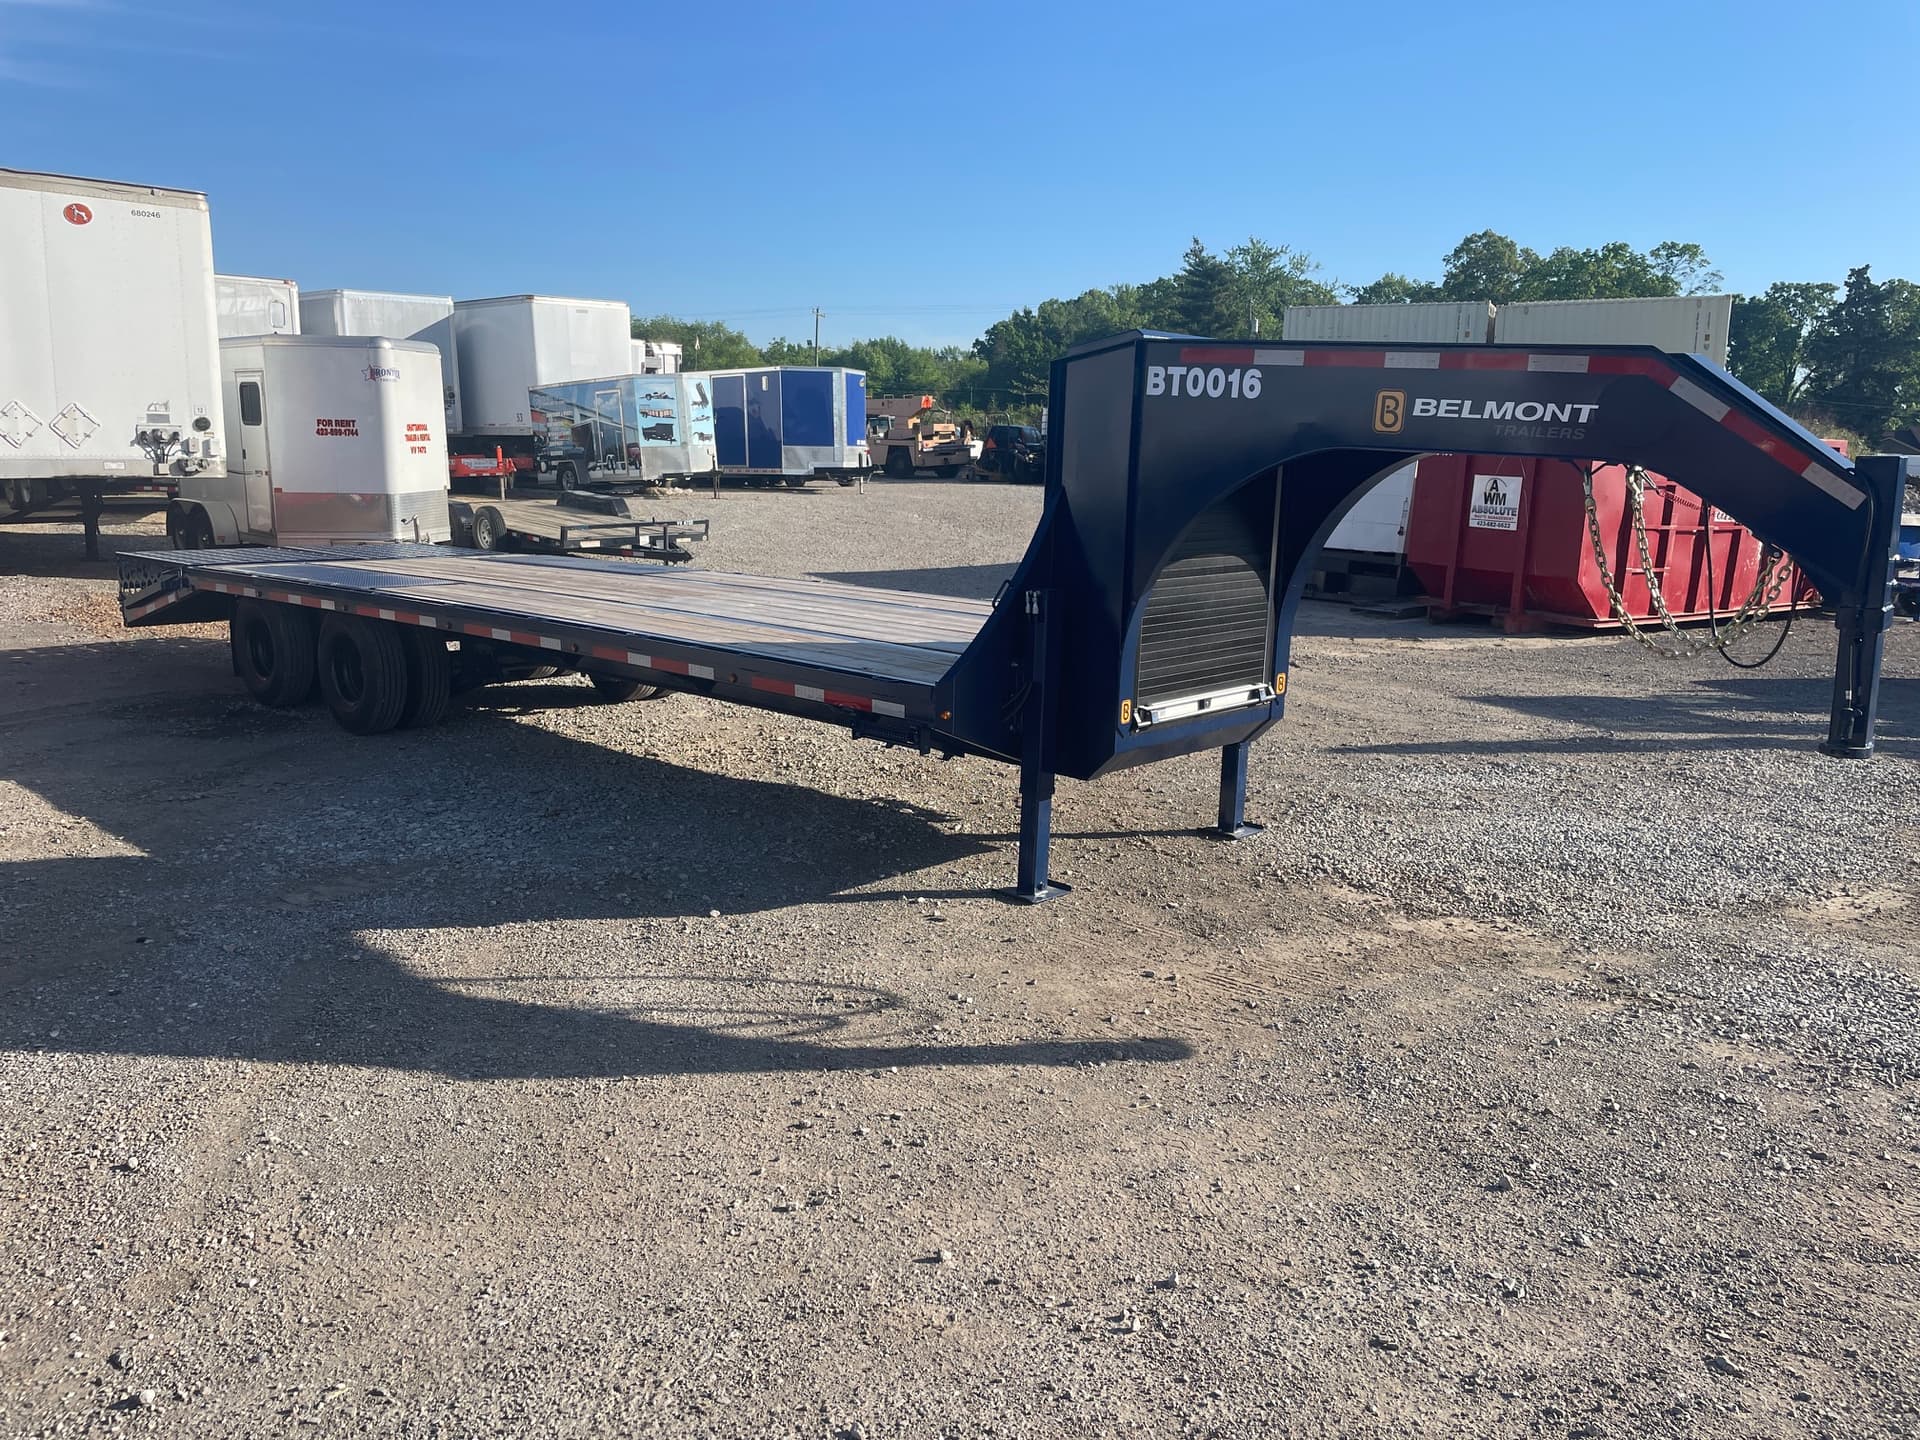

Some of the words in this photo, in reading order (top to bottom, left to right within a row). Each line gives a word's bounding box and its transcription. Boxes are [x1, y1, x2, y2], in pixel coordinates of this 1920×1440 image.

[130, 209, 161, 219] 680246
[1146, 366, 1263, 399] BT0016
[1412, 398, 1599, 424] BELMONT
[316, 418, 333, 427] FOR
[334, 419, 357, 428] RENT
[1494, 424, 1586, 440] TRAILERS
[1489, 479, 1499, 492] A
[1484, 492, 1507, 506] WM
[1471, 505, 1518, 517] ABSOLUTE
